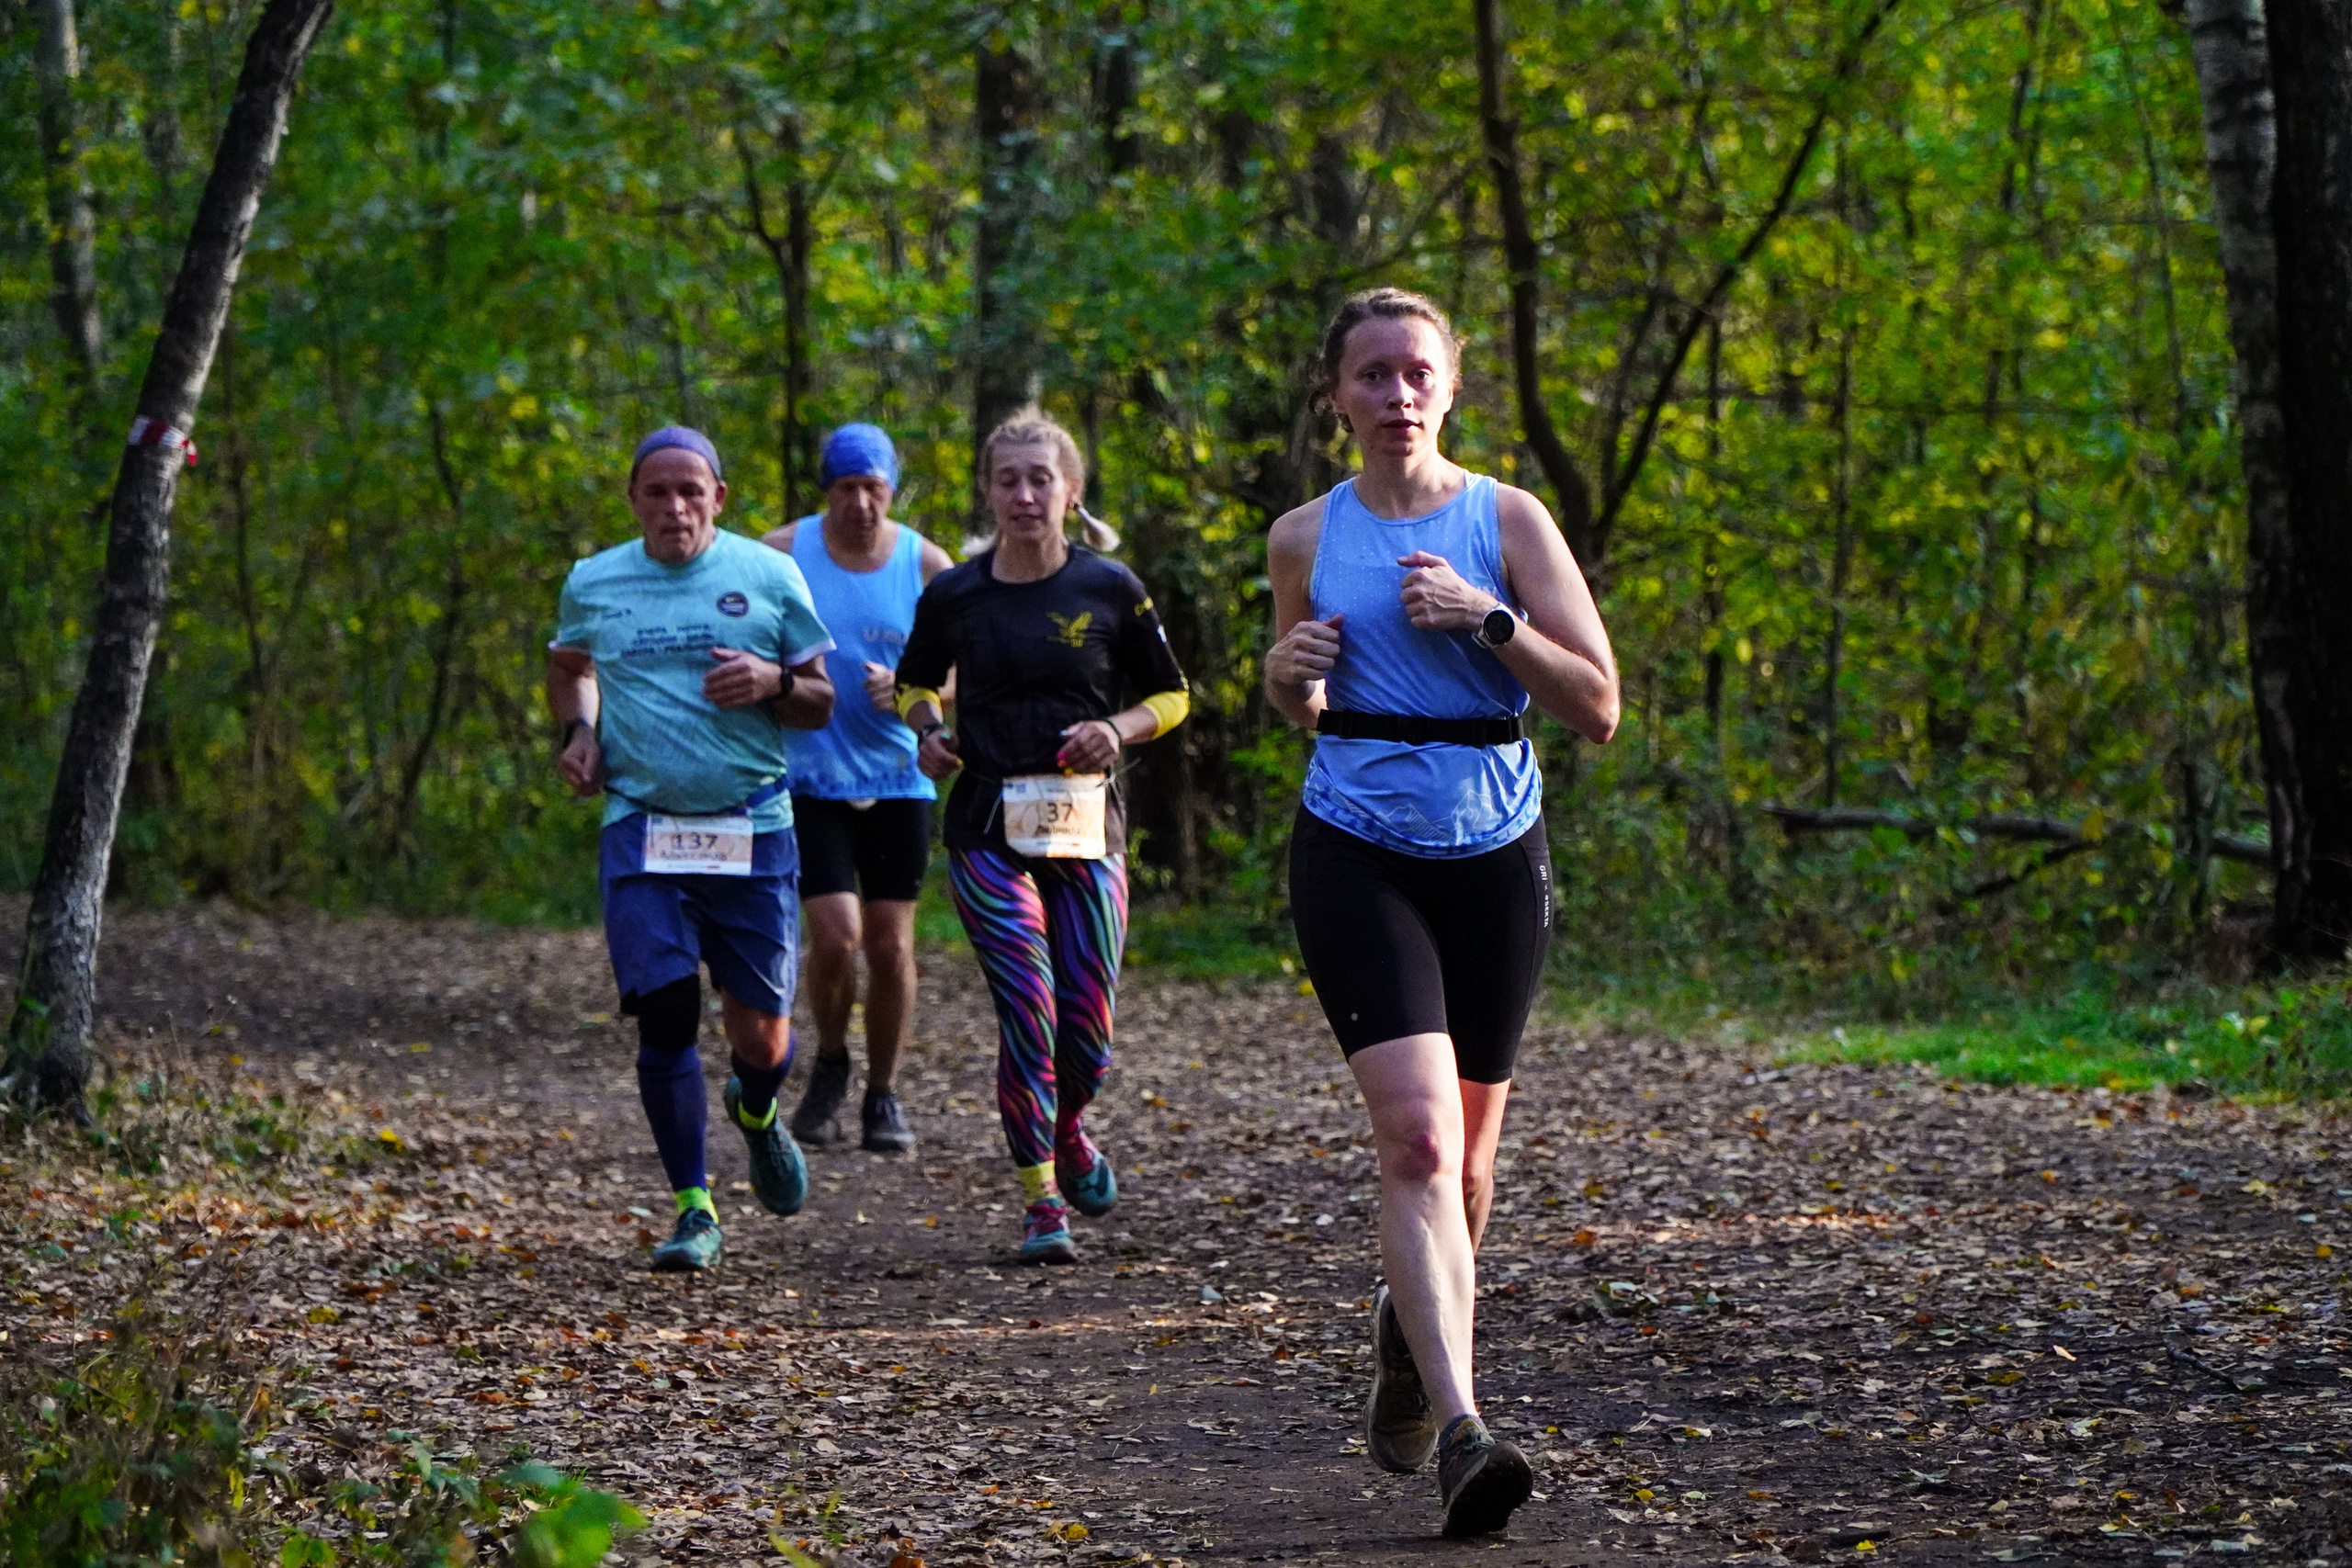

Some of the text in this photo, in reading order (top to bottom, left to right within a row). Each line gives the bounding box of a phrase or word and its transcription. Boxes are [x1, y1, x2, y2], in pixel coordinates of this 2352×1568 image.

[1046, 802, 1074, 822] 37
[671, 831, 718, 850] 137
[1539, 865, 1548, 880] GRI
